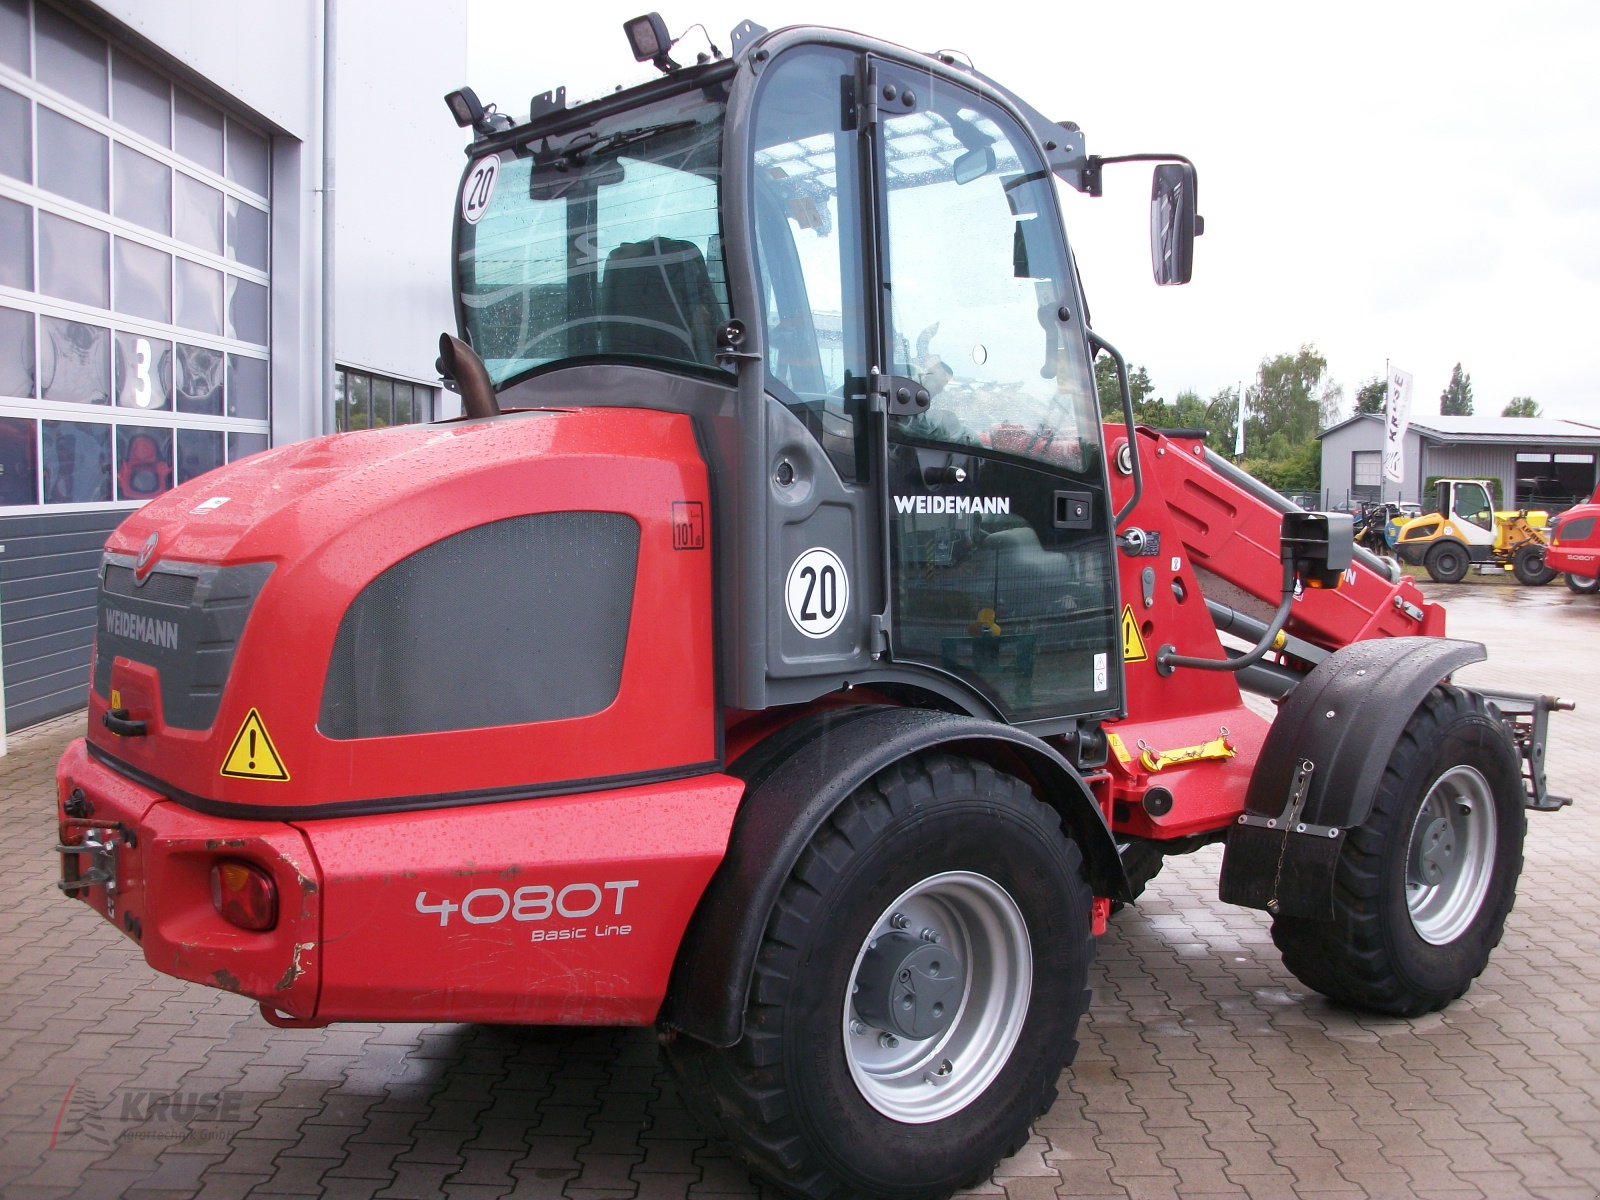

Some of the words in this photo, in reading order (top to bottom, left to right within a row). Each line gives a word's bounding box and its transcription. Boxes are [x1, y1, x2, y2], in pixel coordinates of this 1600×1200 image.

[467, 165, 495, 211] 20
[135, 338, 152, 408] 3
[893, 495, 1010, 515] WEIDEMANN
[676, 523, 694, 546] 101
[799, 565, 837, 621] 20
[105, 607, 178, 651] WEIDEMANN
[415, 879, 639, 927] 4080T
[530, 927, 587, 942] Basic
[594, 924, 632, 938] Line
